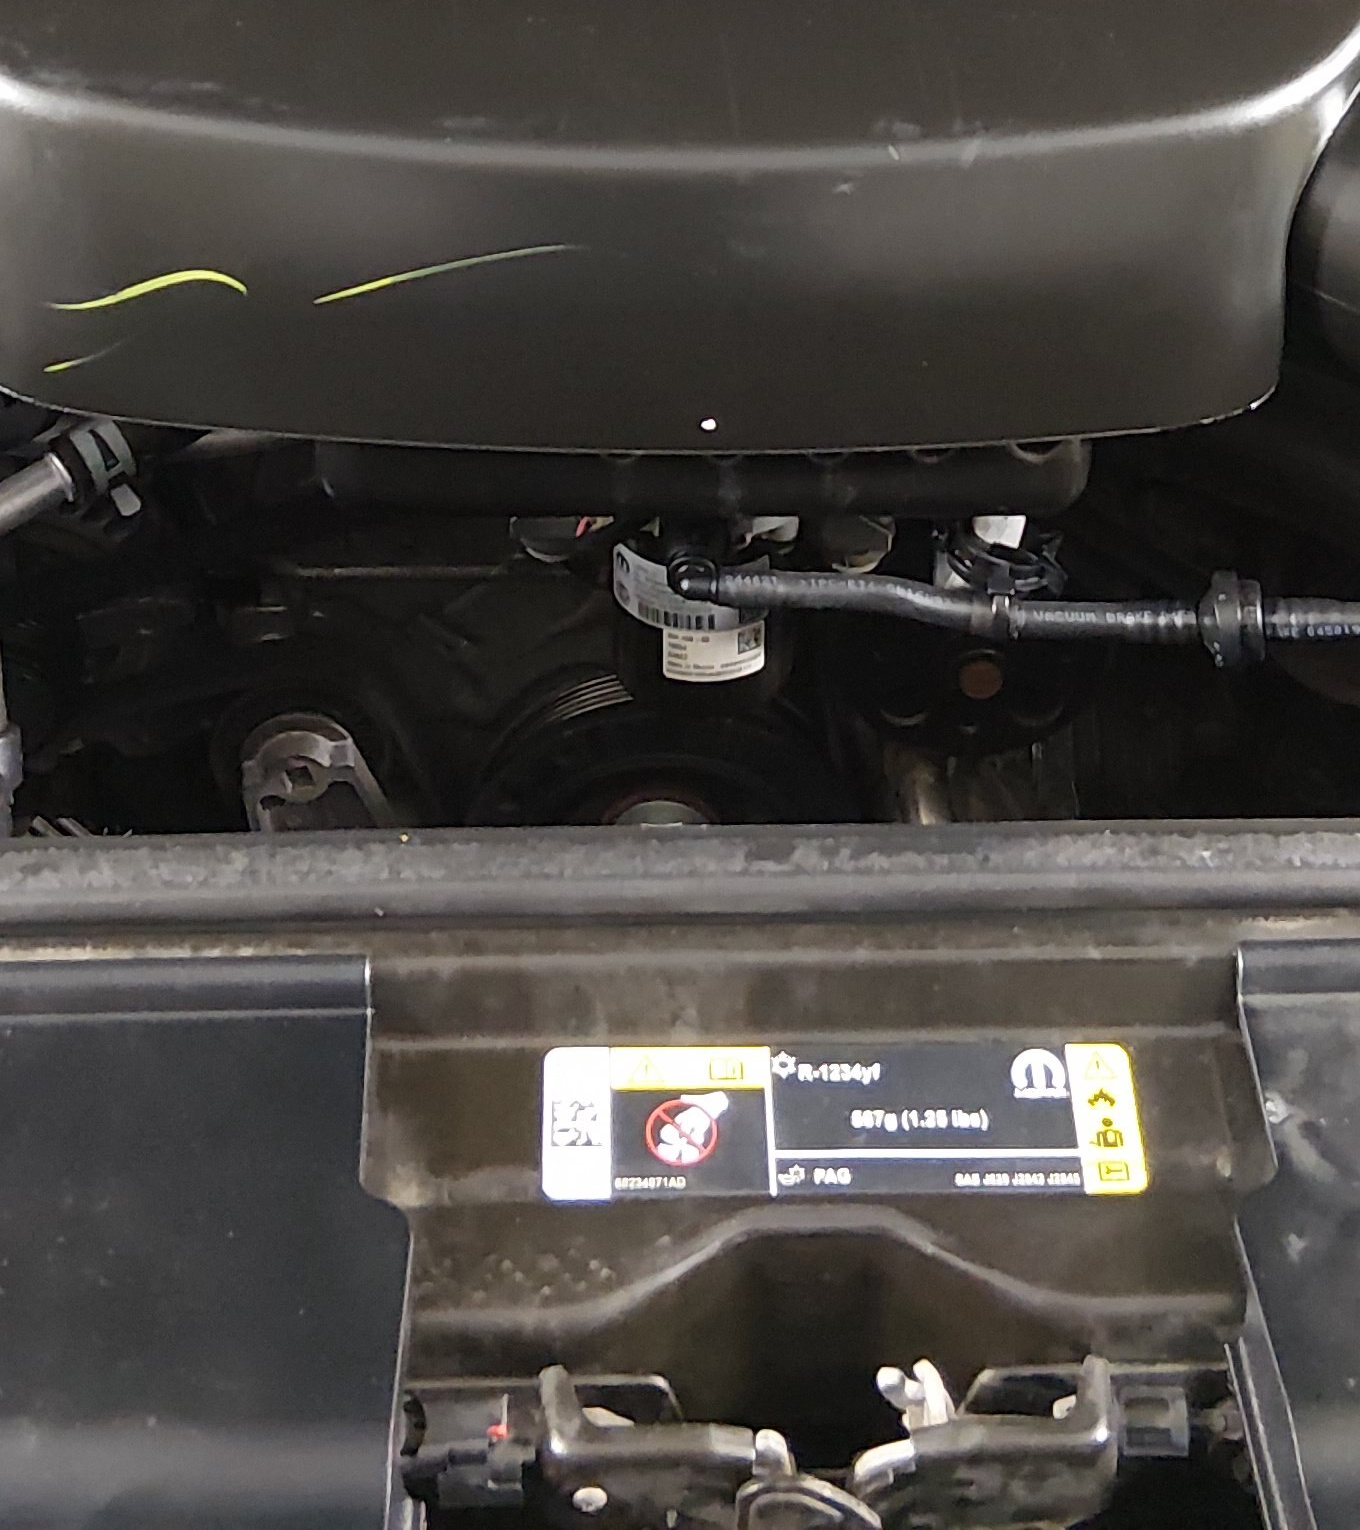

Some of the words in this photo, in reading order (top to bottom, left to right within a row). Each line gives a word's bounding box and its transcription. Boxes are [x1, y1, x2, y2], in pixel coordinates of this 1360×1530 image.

[1032, 609, 1098, 624] VACUUM
[797, 1061, 882, 1086] R-1234yf
[812, 1167, 853, 1186] PAG
